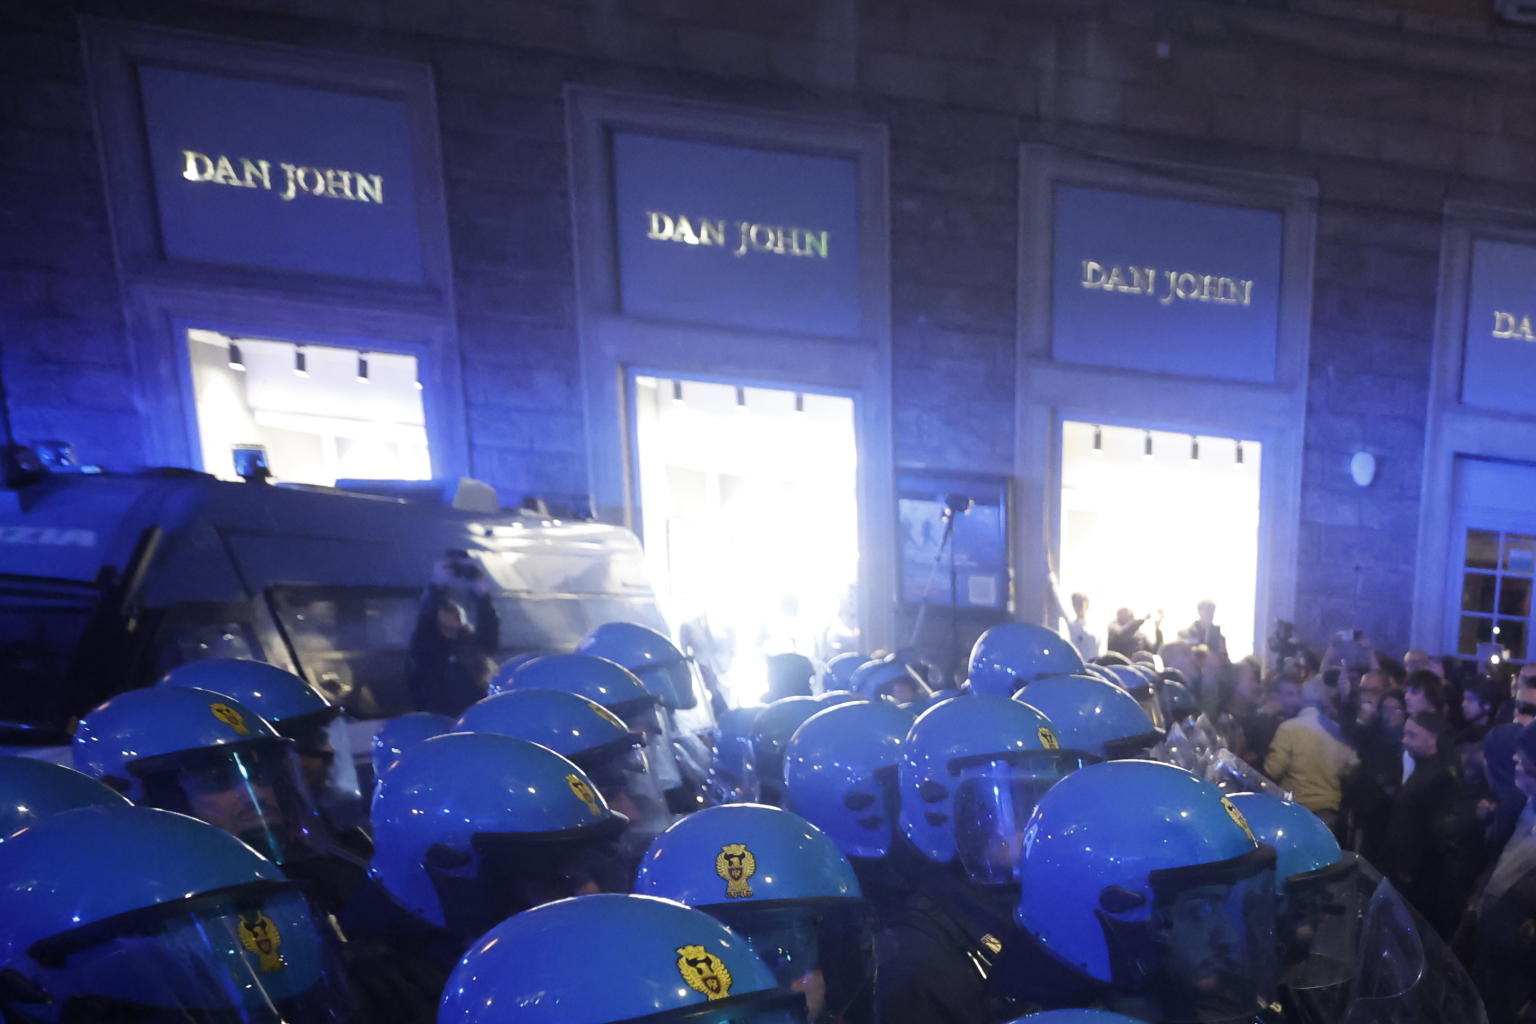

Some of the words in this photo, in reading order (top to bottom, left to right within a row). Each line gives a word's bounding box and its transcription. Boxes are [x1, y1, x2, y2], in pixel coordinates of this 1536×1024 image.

[182, 149, 272, 191] DAN
[279, 161, 384, 204] JOHN
[646, 210, 726, 247] DAN
[733, 220, 830, 259] JOHN
[1081, 260, 1156, 295] DAN
[1159, 269, 1255, 307] JOHN
